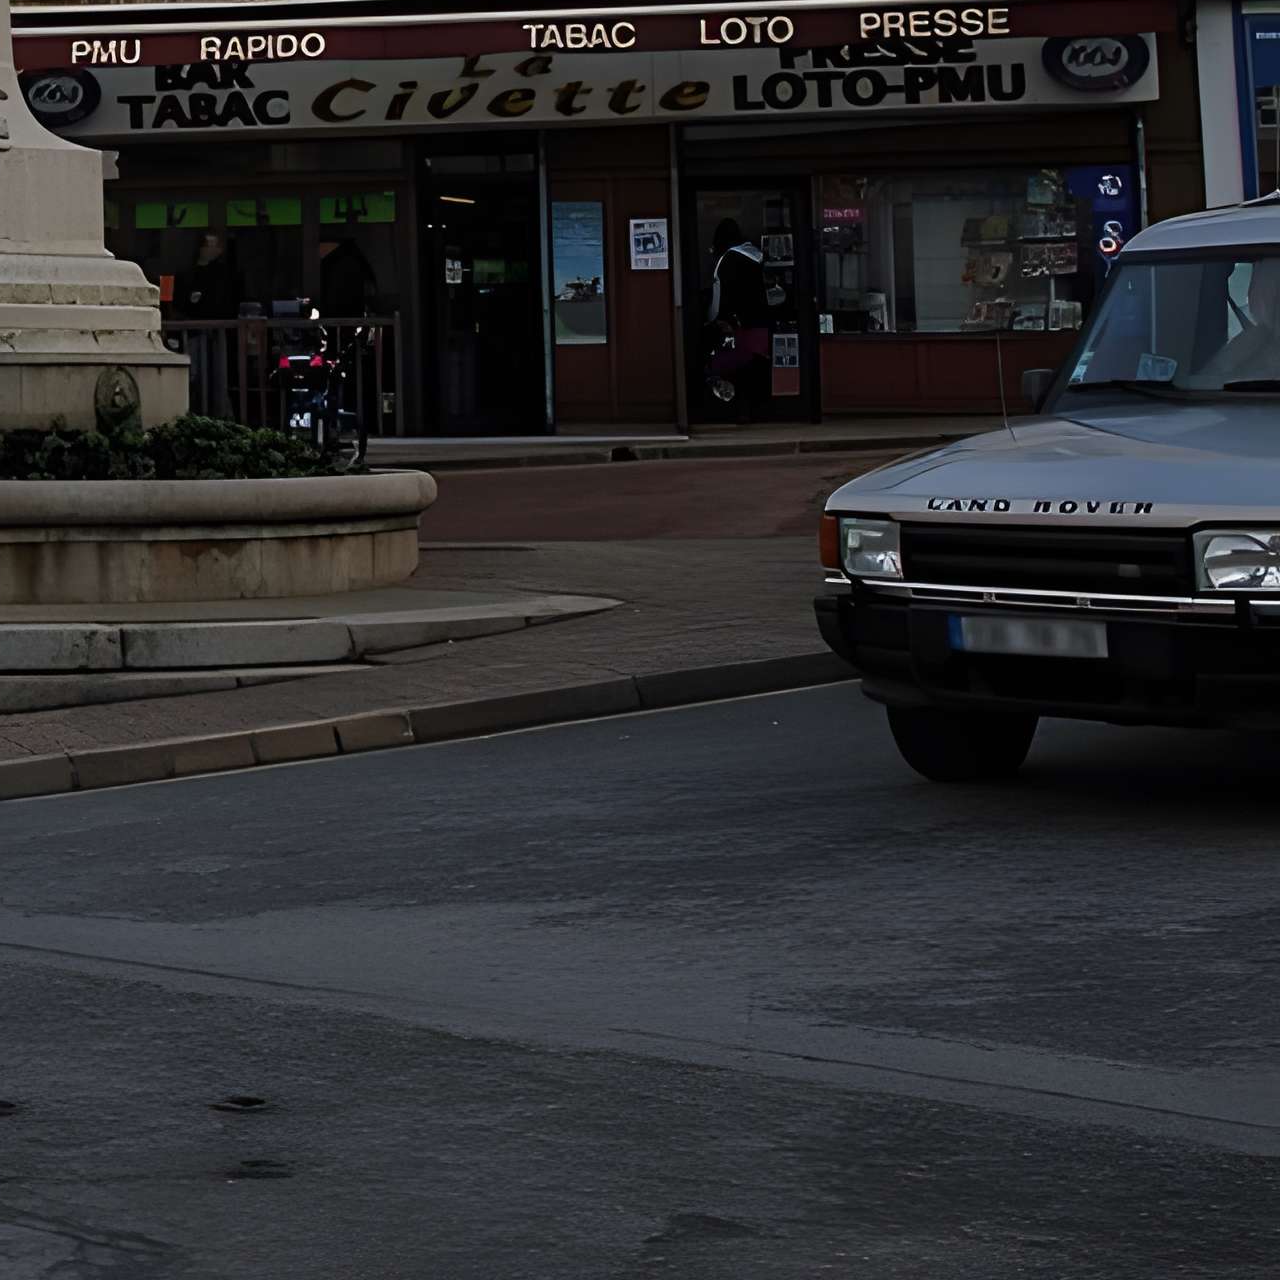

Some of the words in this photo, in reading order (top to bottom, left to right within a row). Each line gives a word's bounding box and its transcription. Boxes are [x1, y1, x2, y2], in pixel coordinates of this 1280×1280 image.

[71, 39, 142, 65] PMU
[200, 32, 326, 61] RAPIDO
[522, 21, 637, 49] TABAC
[700, 15, 795, 45] LOTO
[859, 7, 1011, 39] PRESSE
[311, 77, 710, 121] Civette
[733, 63, 1025, 111] LOTO-PMU
[116, 90, 290, 129] TABAC
[927, 497, 1011, 513] LAND
[1033, 500, 1154, 514] ROVER
